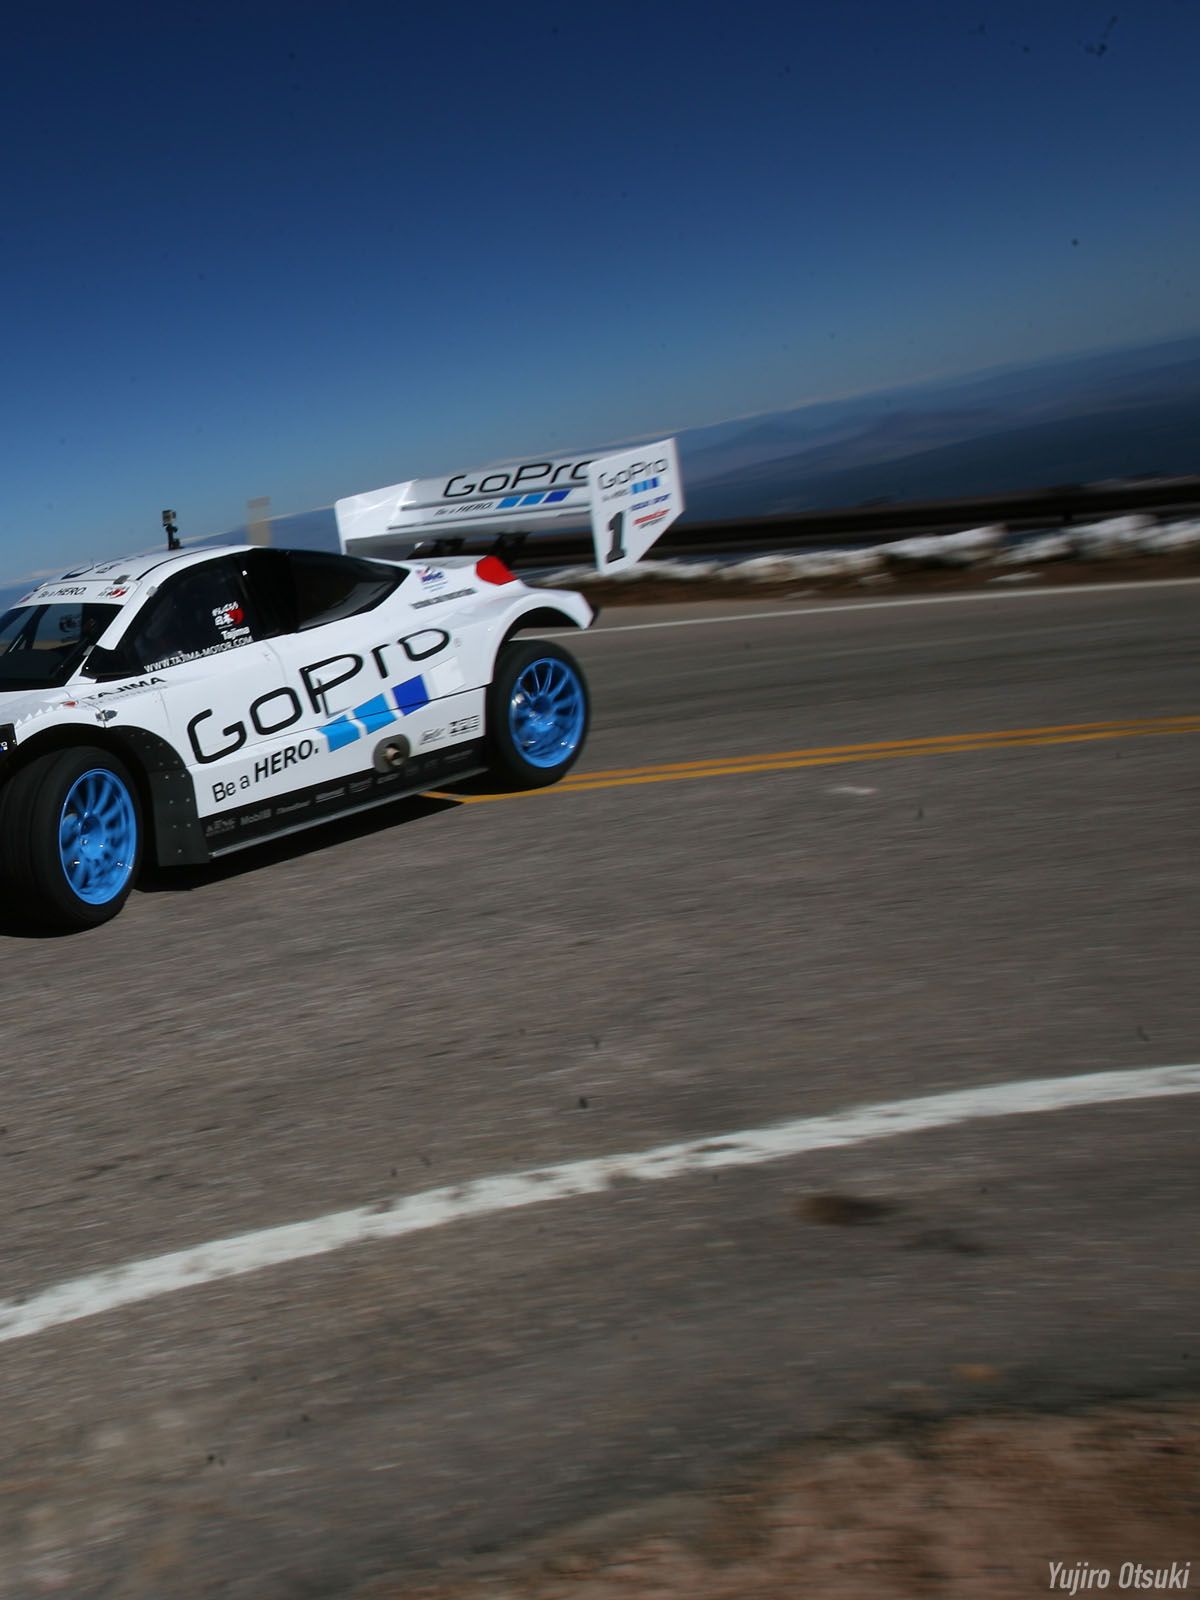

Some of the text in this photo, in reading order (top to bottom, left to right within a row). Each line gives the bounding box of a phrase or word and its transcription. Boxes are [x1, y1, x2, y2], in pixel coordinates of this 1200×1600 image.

[598, 459, 668, 489] GoPro
[605, 511, 626, 564] 1
[221, 626, 250, 640] Tajima
[82, 677, 166, 700] TAJIMA
[187, 628, 450, 764] GoPro
[212, 739, 319, 803] Be a HERO.
